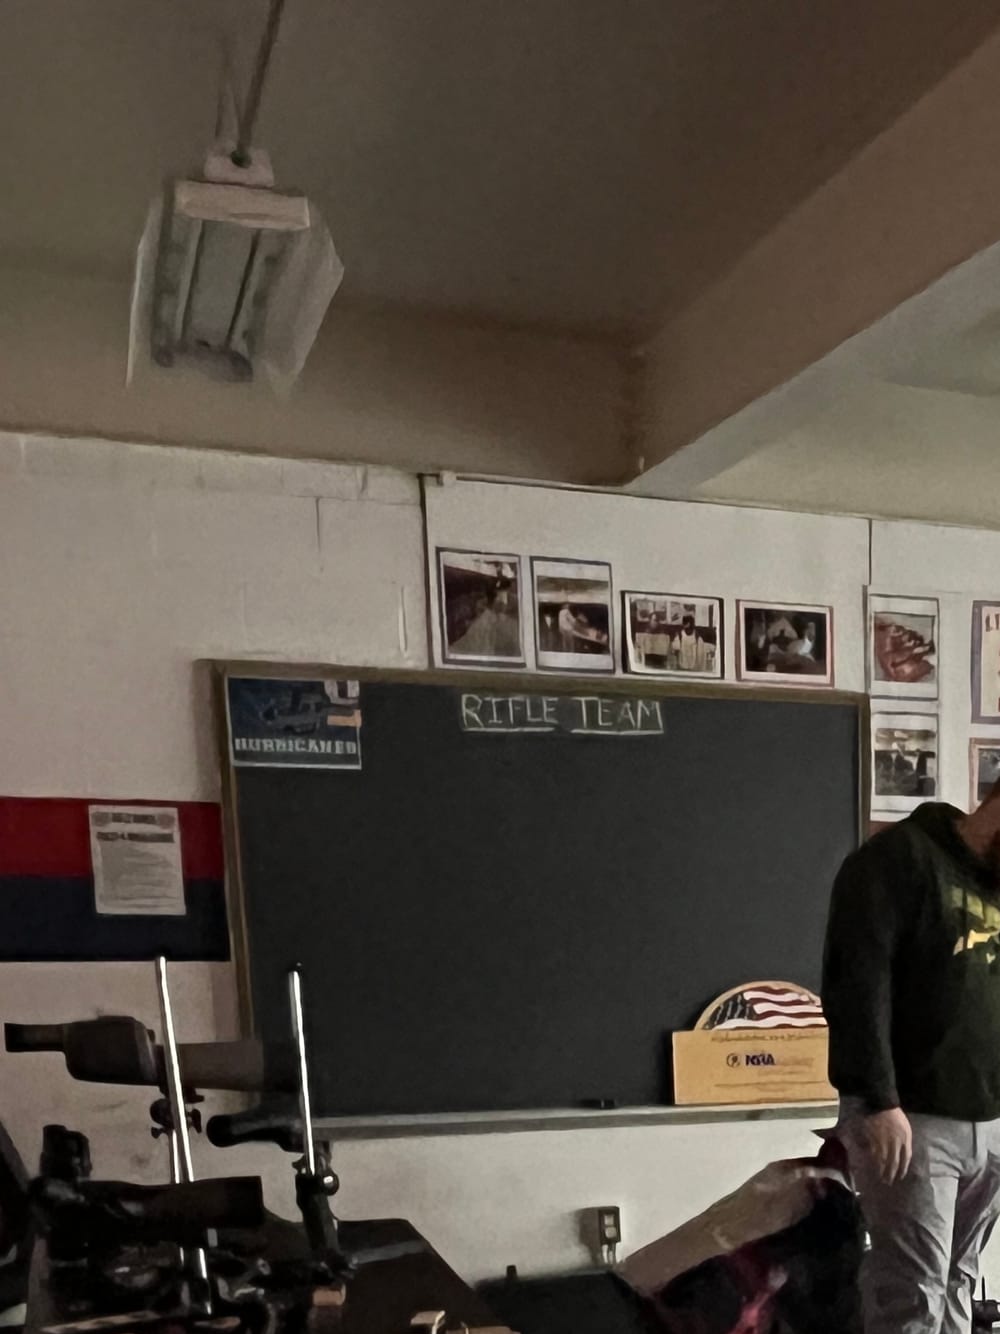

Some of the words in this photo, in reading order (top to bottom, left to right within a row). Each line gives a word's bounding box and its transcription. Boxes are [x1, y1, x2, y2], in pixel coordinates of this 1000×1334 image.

[461, 694, 559, 728] RIFLE
[570, 696, 664, 729] TEAM
[234, 738, 357, 754] HURRICANES
[745, 1053, 776, 1067] NRA
